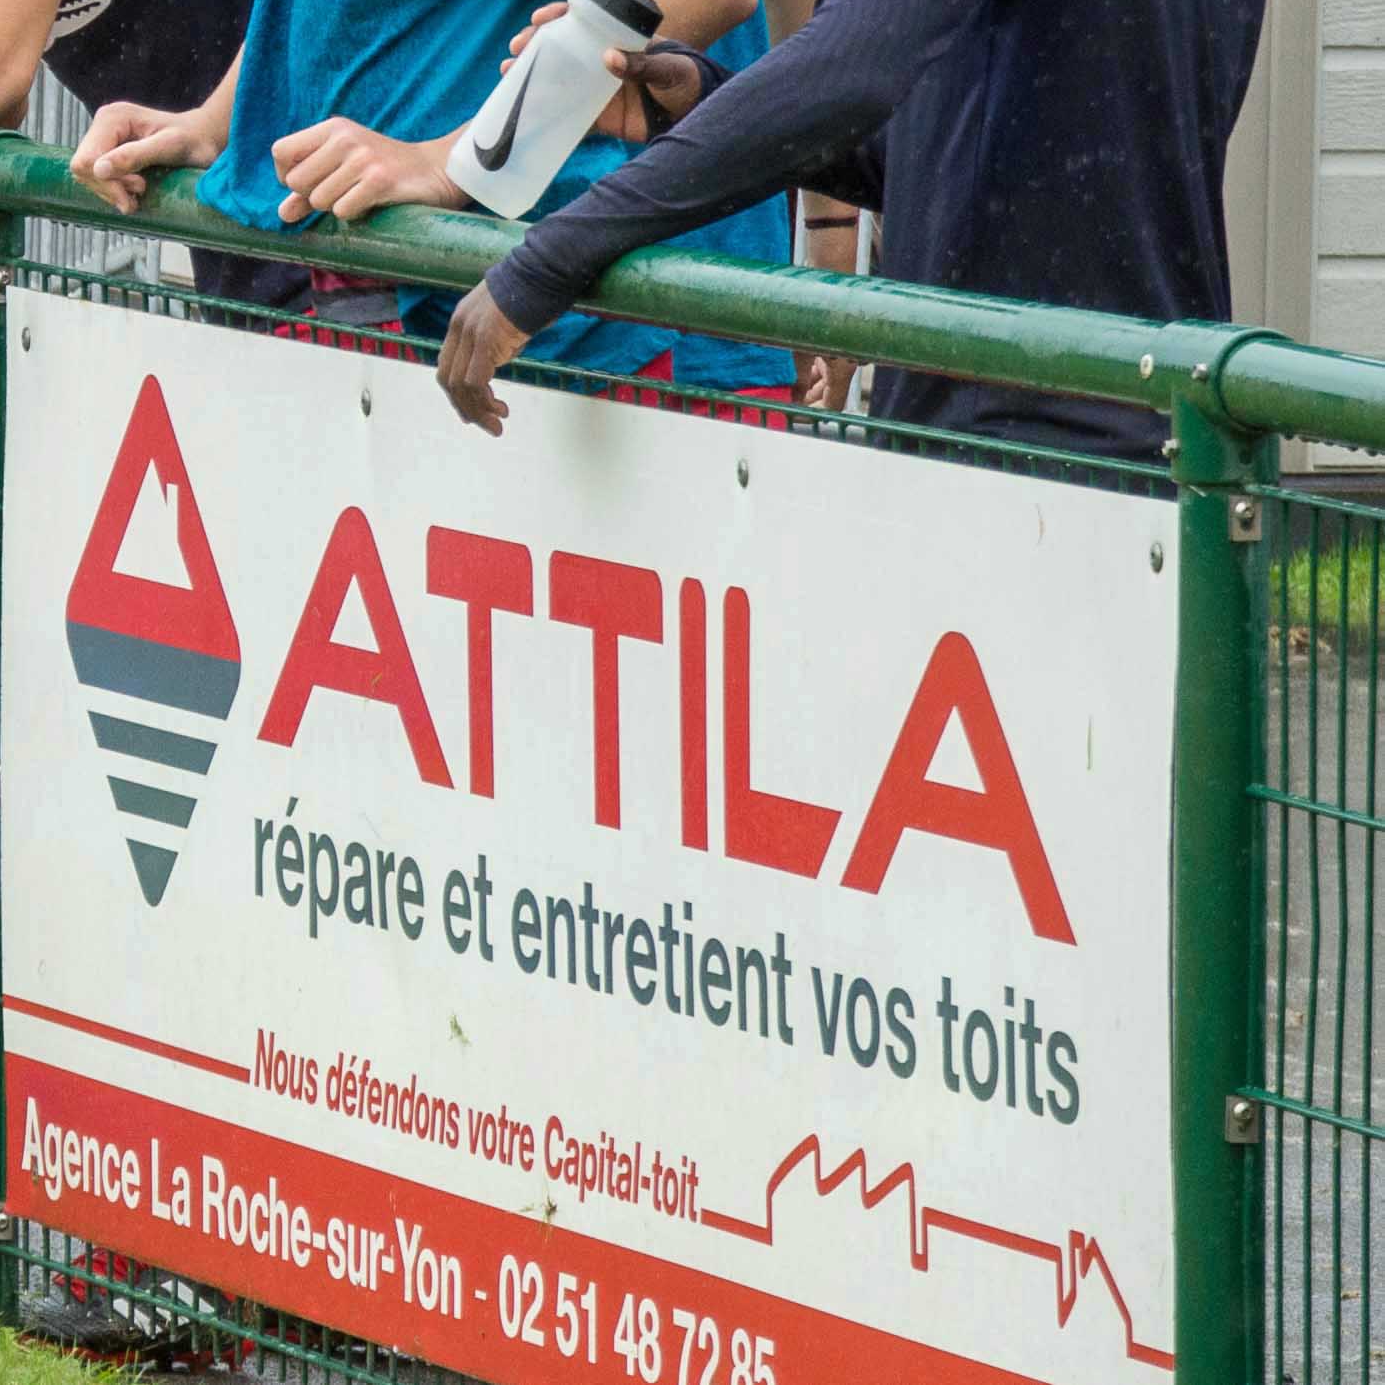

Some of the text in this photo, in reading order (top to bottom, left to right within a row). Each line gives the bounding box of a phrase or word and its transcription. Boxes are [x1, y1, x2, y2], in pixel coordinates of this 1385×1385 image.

[256, 504, 1078, 947] ATTILA
[254, 796, 1081, 1126] répare et entretient vos toits
[20, 1096, 141, 1211] Agence
[150, 1138, 191, 1230] La
[202, 1155, 462, 1320] Roche-sur-Yon
[498, 1254, 546, 1348] 02
[555, 1272, 598, 1365] 51
[614, 1293, 663, 1384] 48
[672, 1309, 721, 1385] 72
[730, 1328, 777, 1385] 85
[253, 1028, 701, 1223] Nous défendons votre Capital-toit
